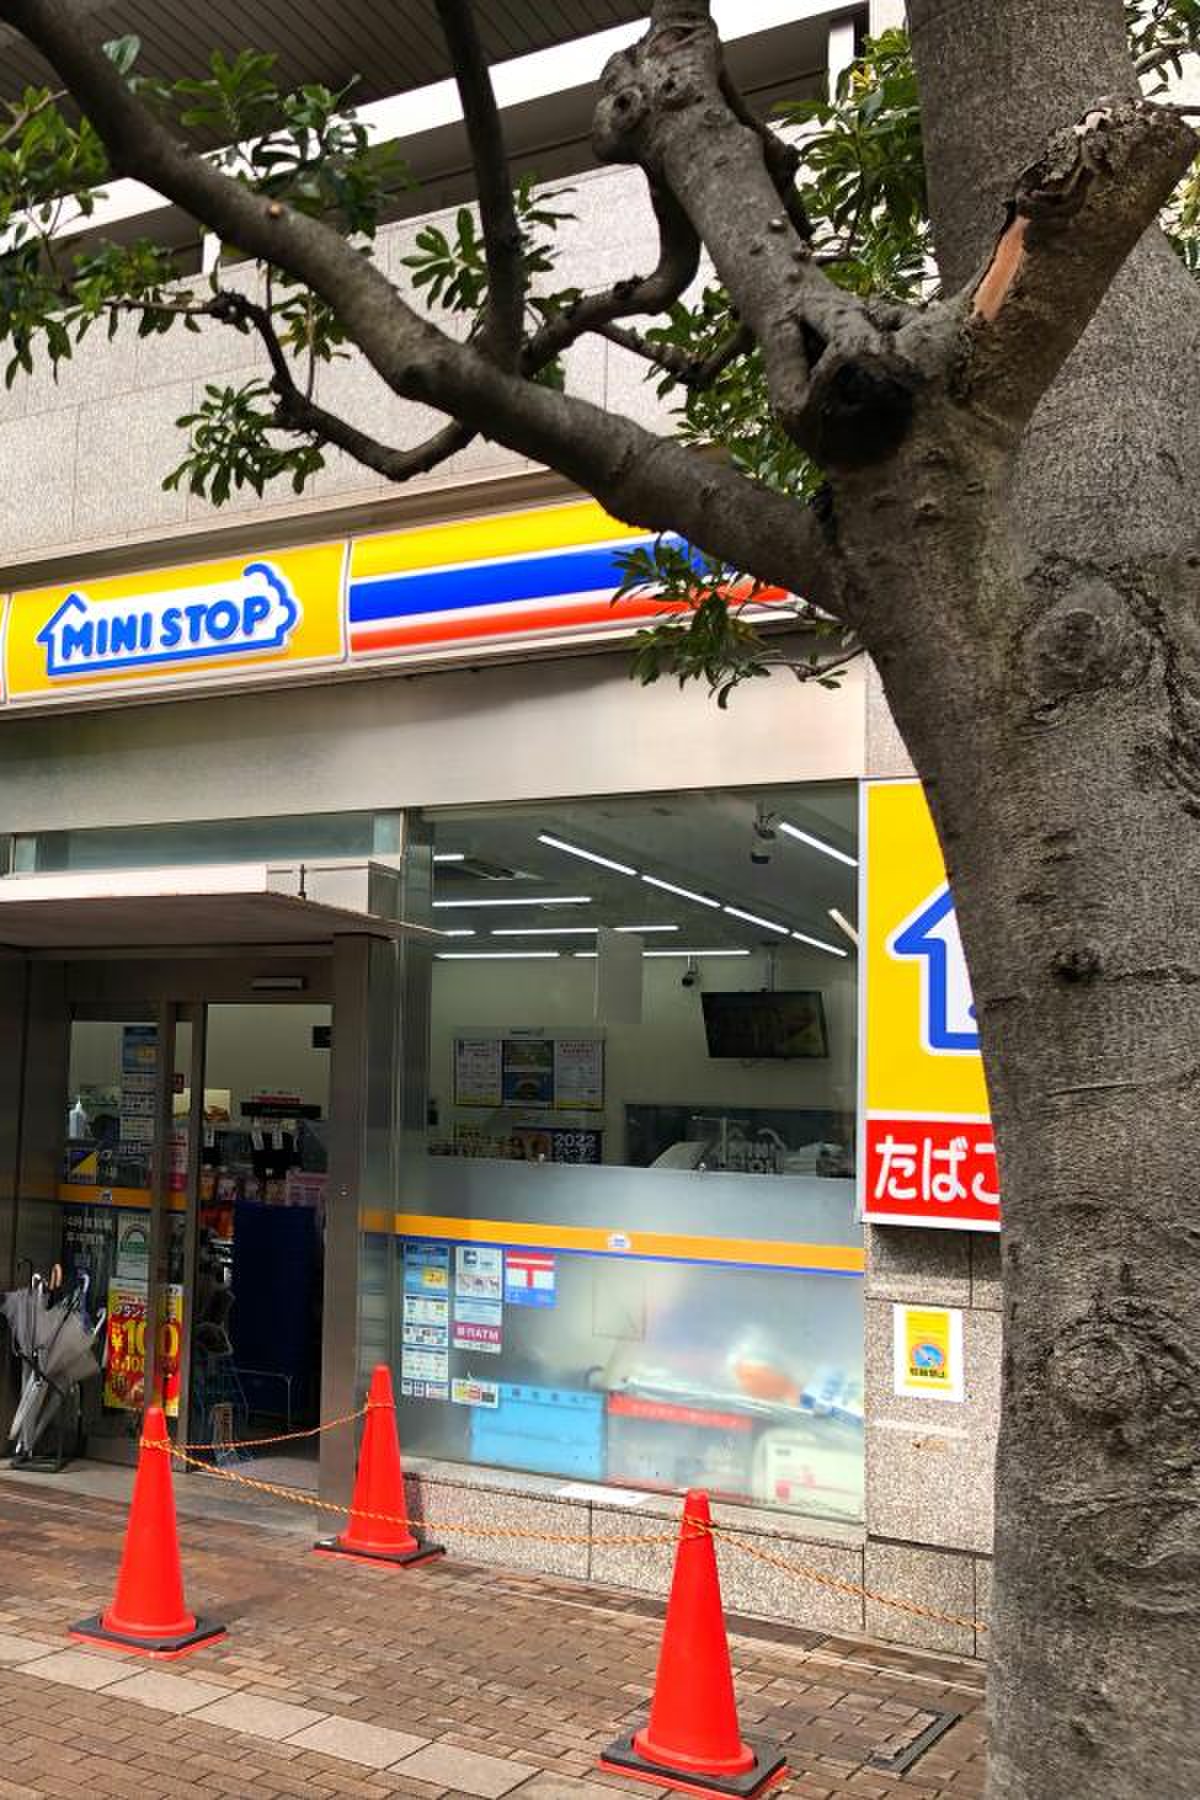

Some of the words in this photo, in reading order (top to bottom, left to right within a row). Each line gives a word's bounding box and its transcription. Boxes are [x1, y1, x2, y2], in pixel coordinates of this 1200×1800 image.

[61, 612, 153, 660] MINI
[160, 596, 271, 647] STOP
[874, 1134, 1001, 1205] たばこ
